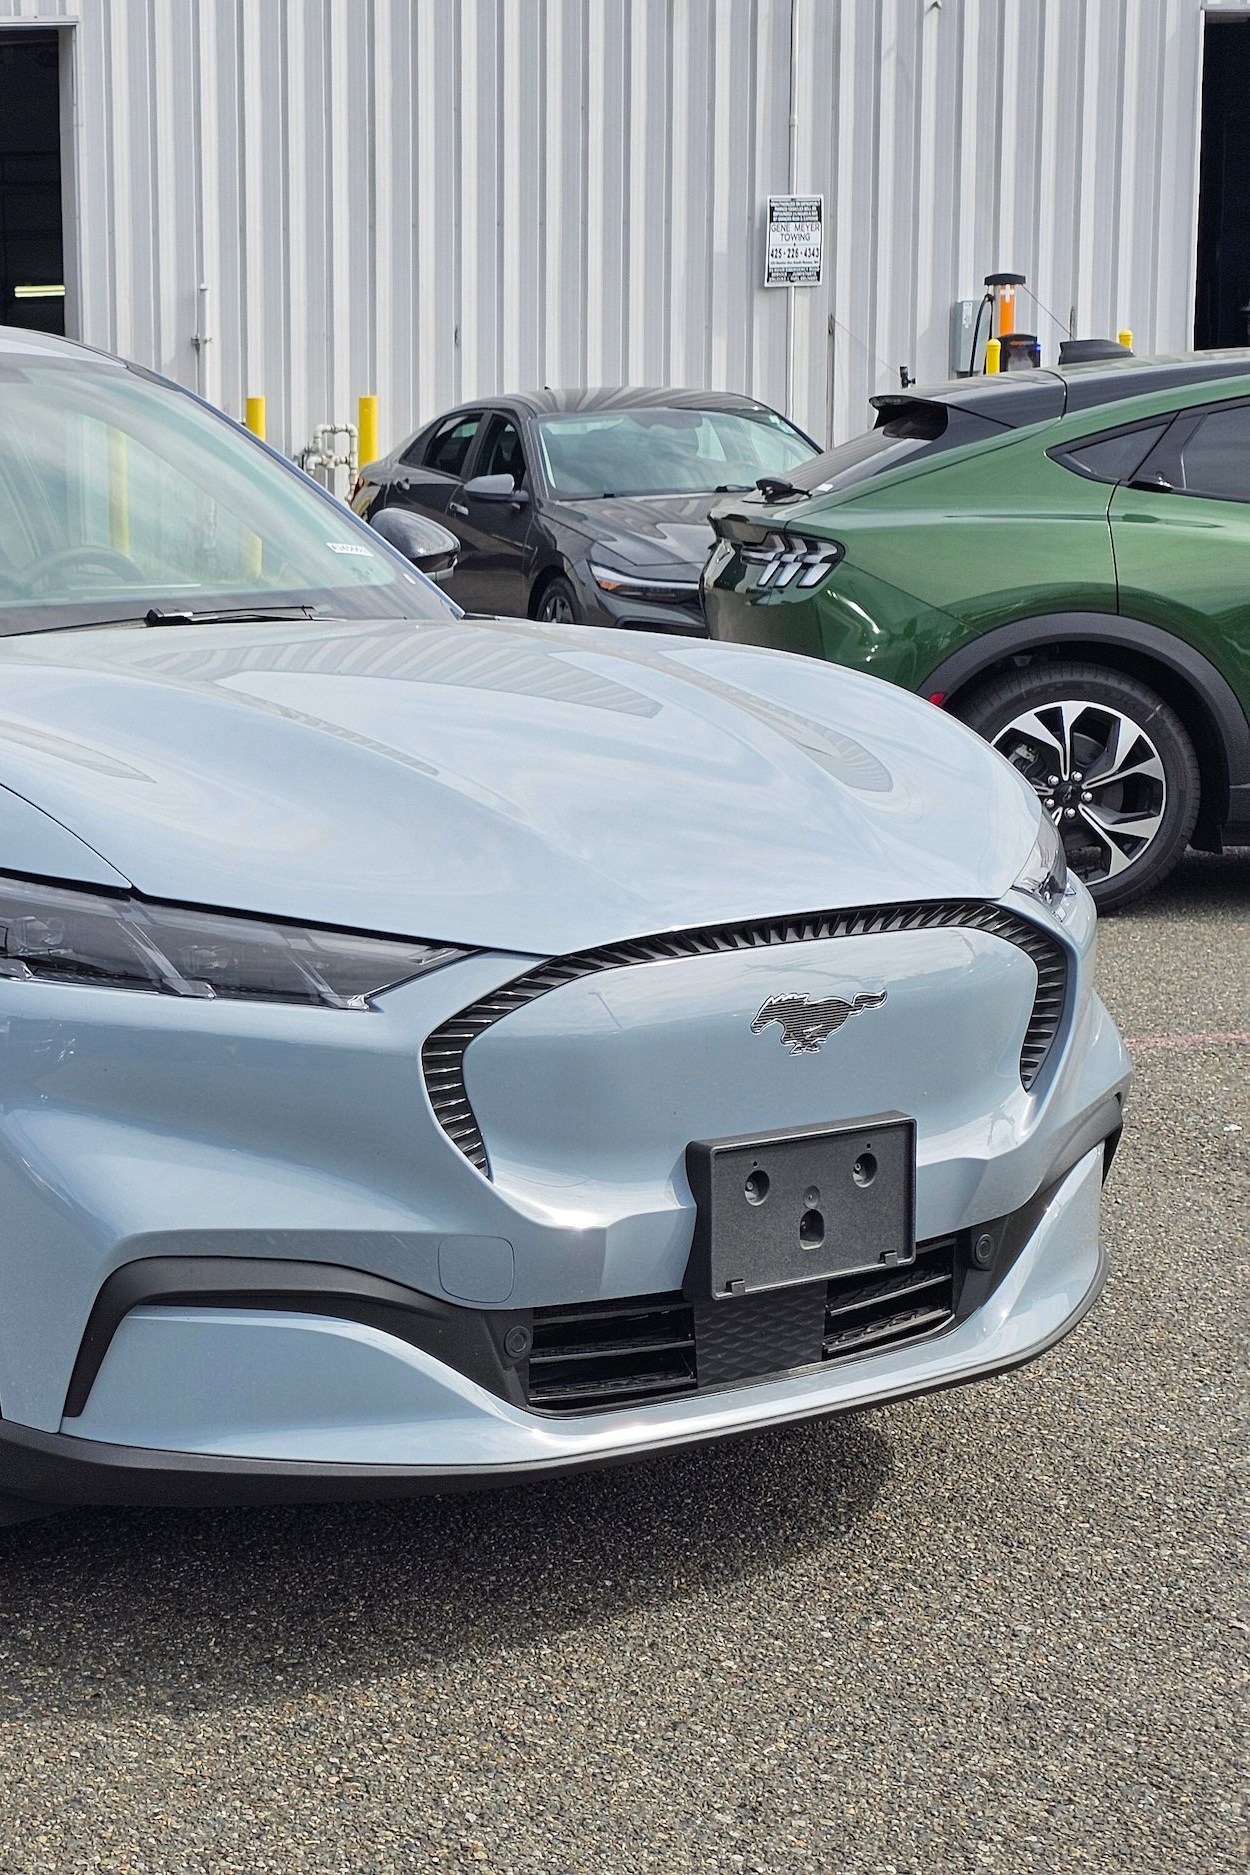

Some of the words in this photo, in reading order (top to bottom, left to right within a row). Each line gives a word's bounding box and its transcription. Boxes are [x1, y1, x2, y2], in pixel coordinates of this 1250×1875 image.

[770, 223, 790, 232] GENE
[794, 223, 820, 232] MEYER
[780, 233, 811, 241] TOWING
